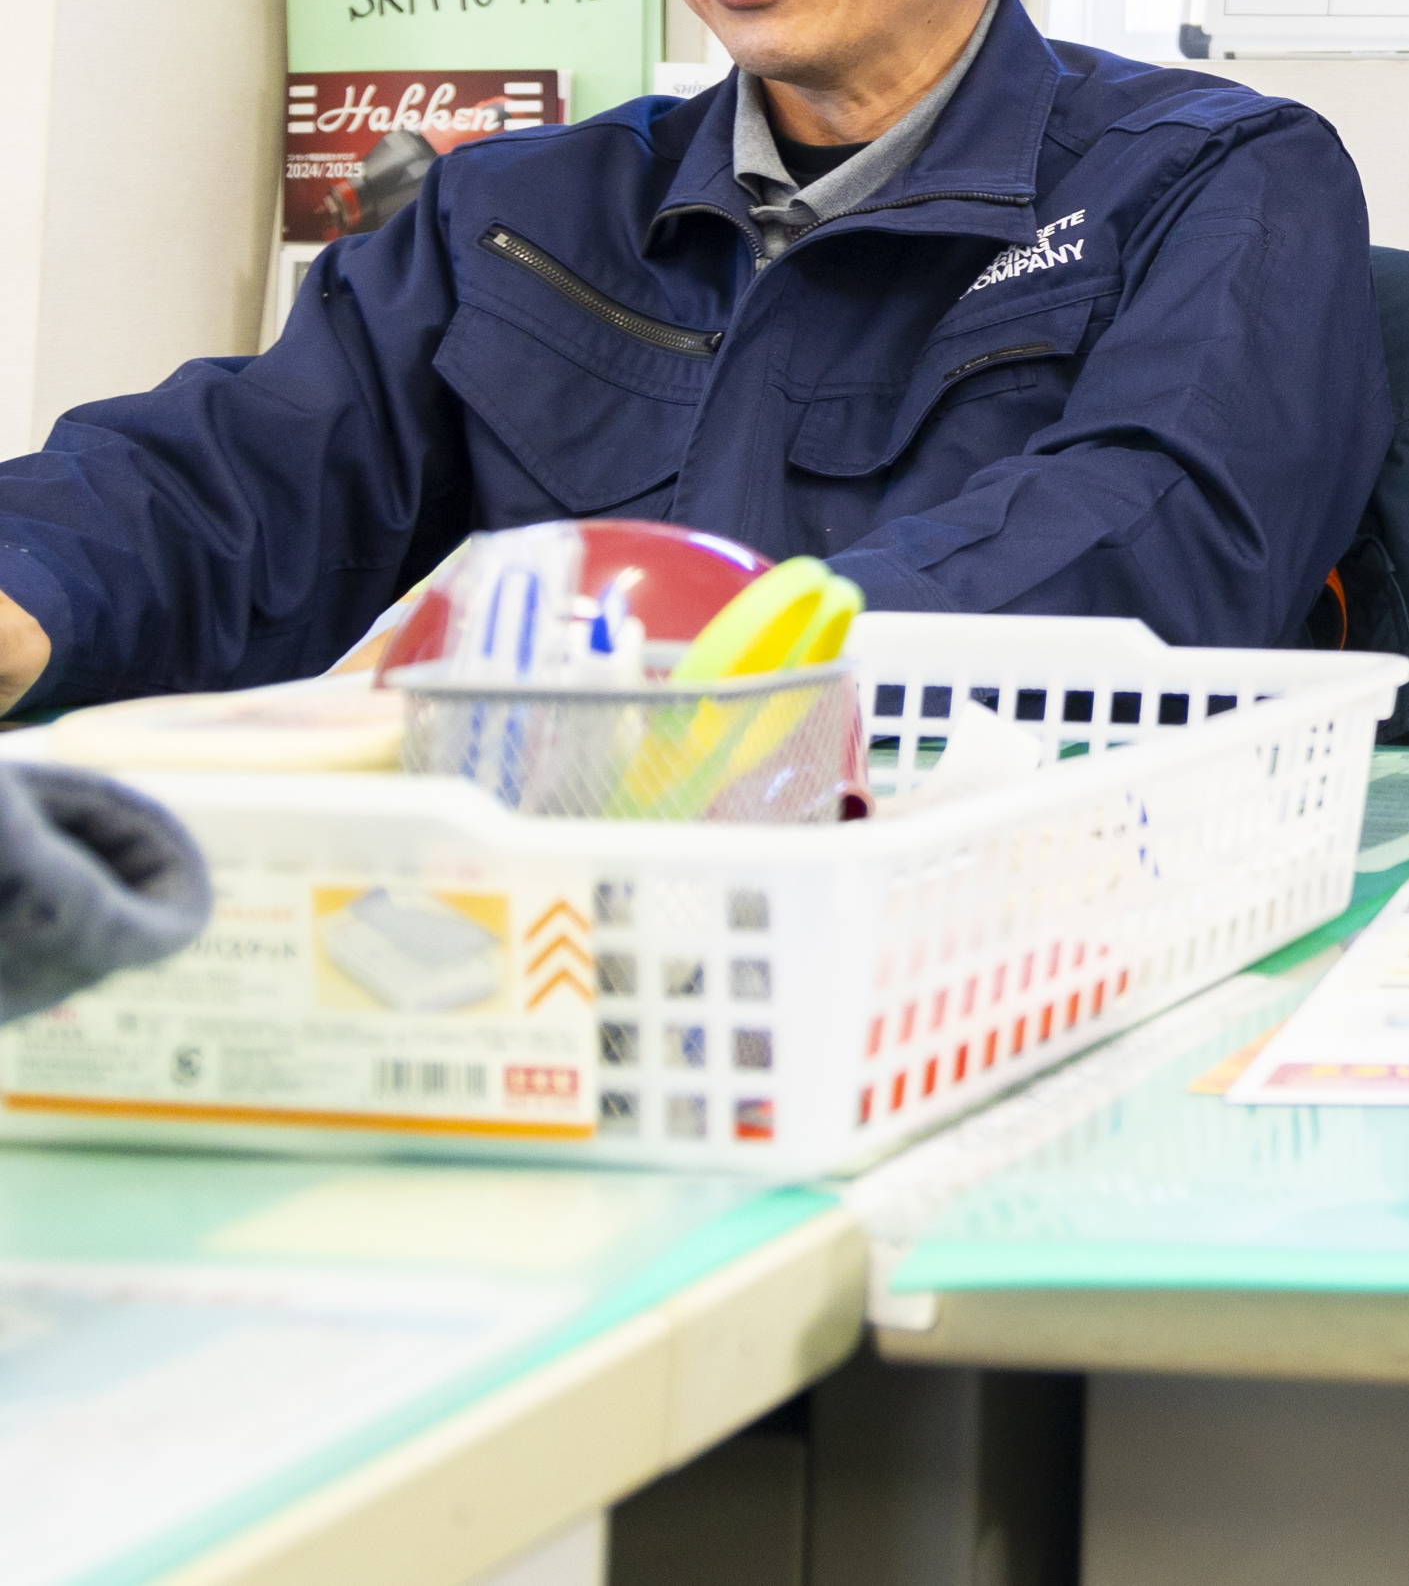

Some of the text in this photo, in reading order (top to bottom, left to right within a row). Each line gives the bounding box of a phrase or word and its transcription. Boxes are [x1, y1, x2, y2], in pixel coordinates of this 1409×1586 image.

[316, 83, 505, 133] Hakken
[285, 162, 364, 179] 2024/2025
[959, 239, 1084, 300] OMPANY
